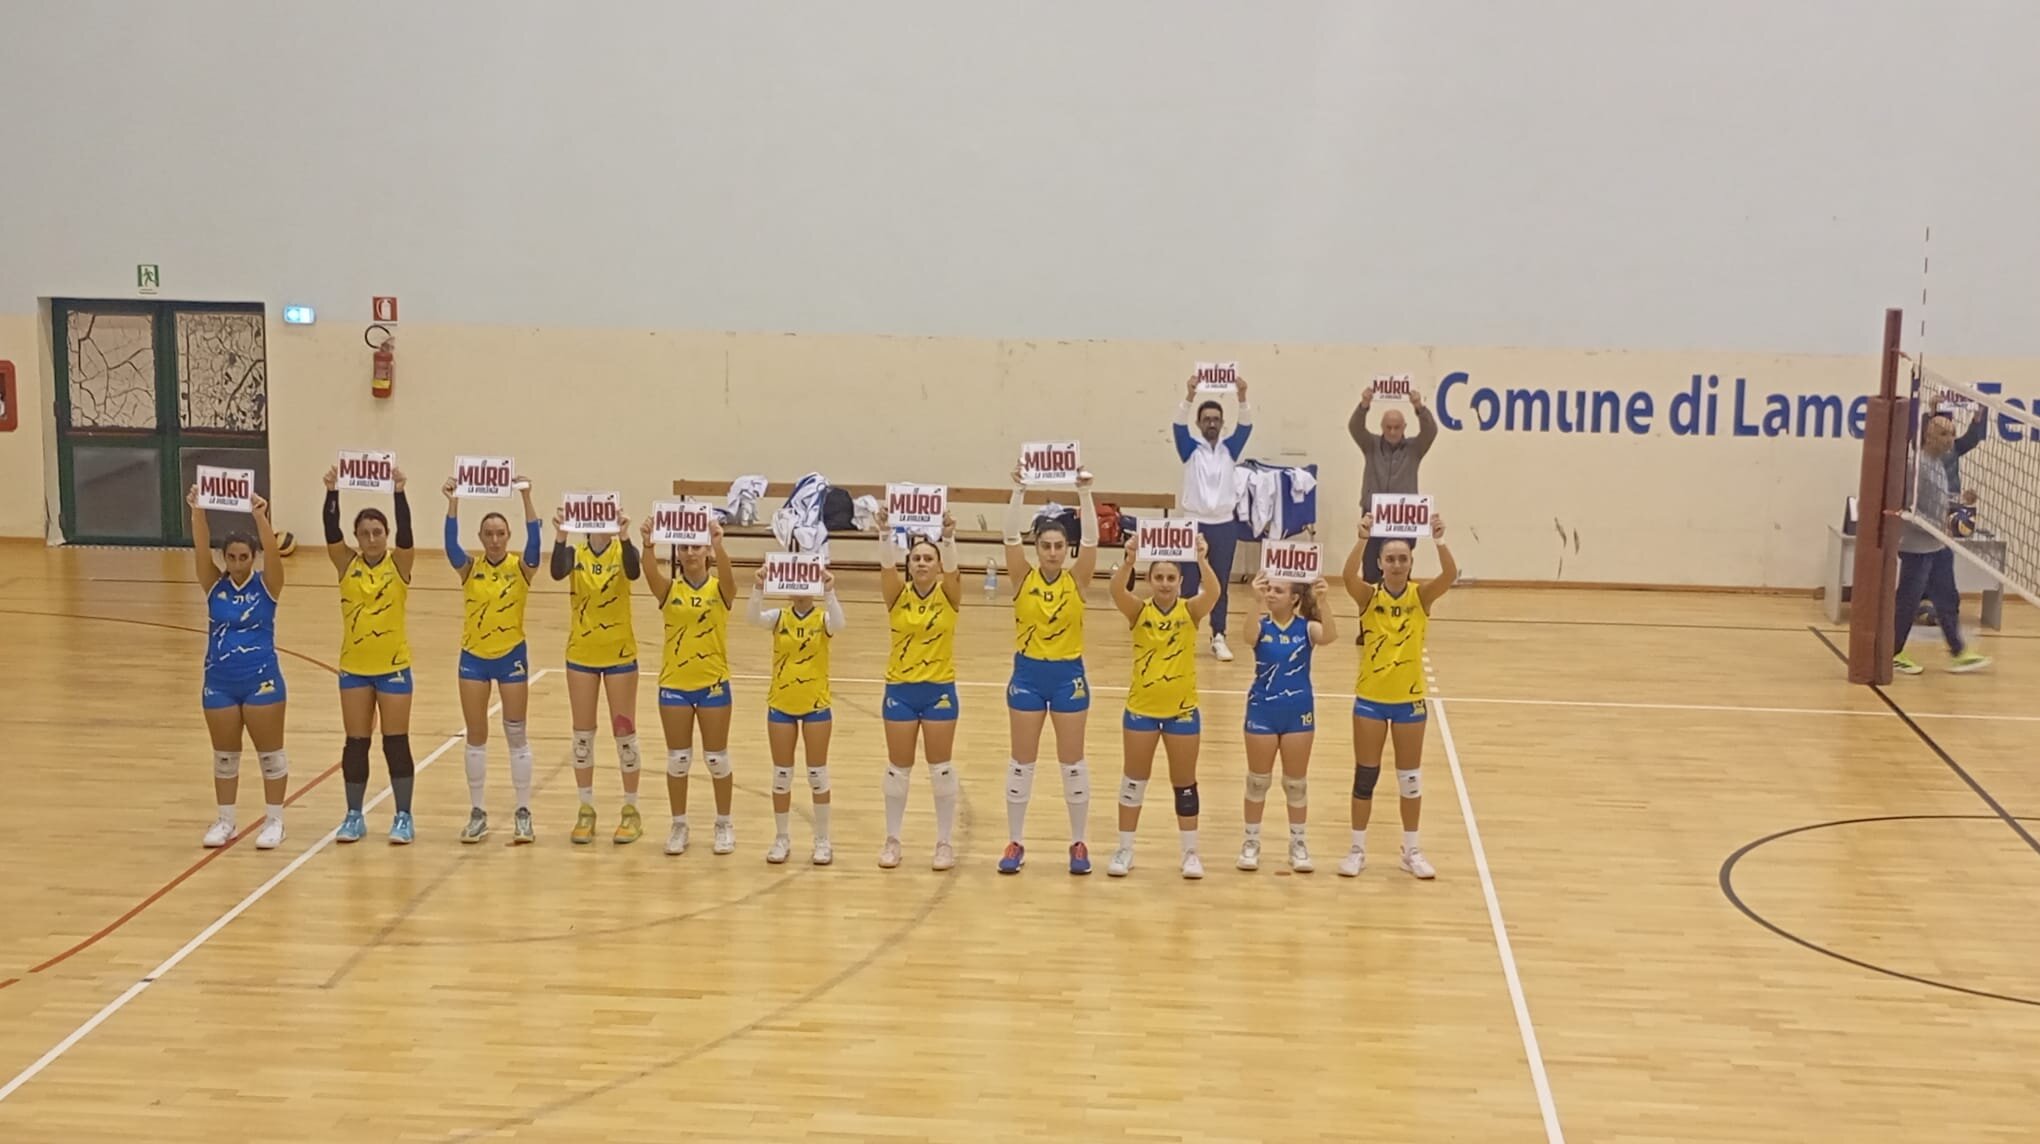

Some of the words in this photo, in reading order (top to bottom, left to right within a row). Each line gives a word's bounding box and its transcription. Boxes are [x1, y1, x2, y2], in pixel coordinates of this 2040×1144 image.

[1436, 371, 1654, 435] Comune
[1669, 374, 1719, 436] di
[691, 596, 702, 608] 12
[1390, 605, 1401, 618] 10
